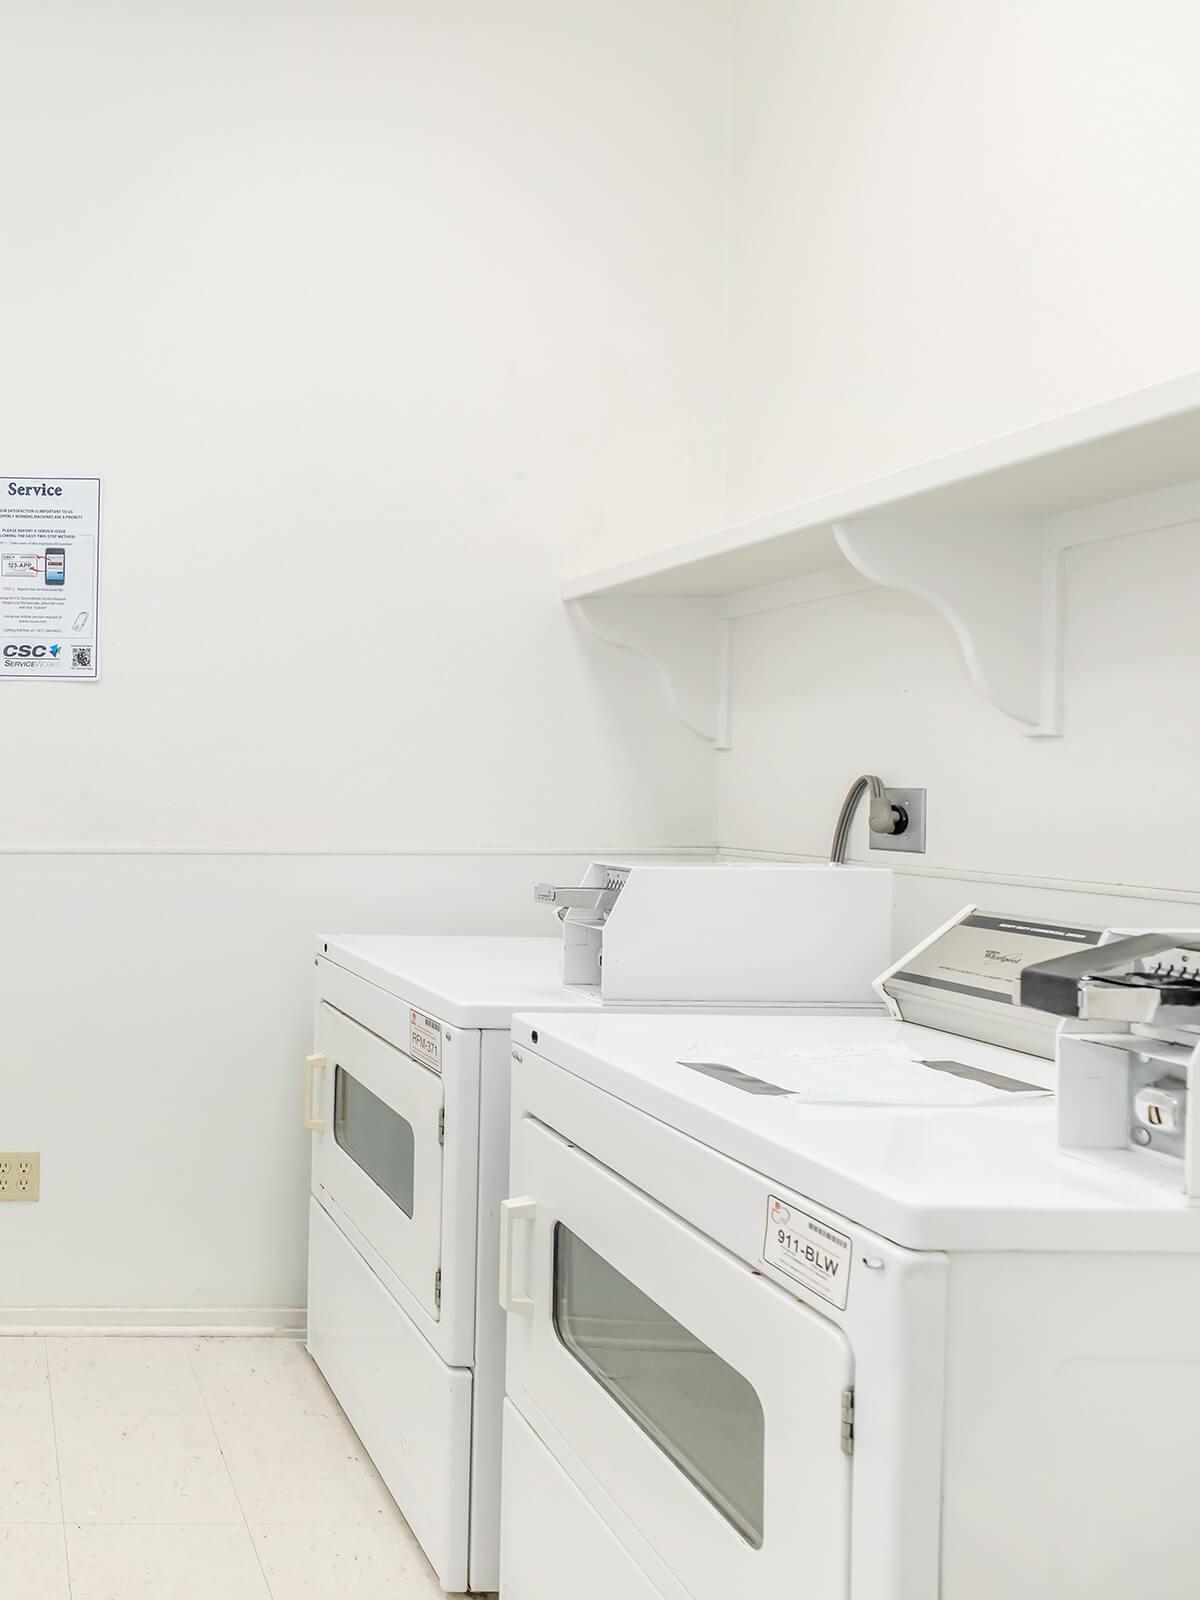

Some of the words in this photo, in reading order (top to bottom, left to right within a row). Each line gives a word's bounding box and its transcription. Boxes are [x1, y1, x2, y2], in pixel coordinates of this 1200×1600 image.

[8, 482, 63, 496] Service
[3, 644, 47, 657] CSC
[984, 949, 1022, 964] Whirlpool
[777, 1229, 839, 1277] 911-BLW
